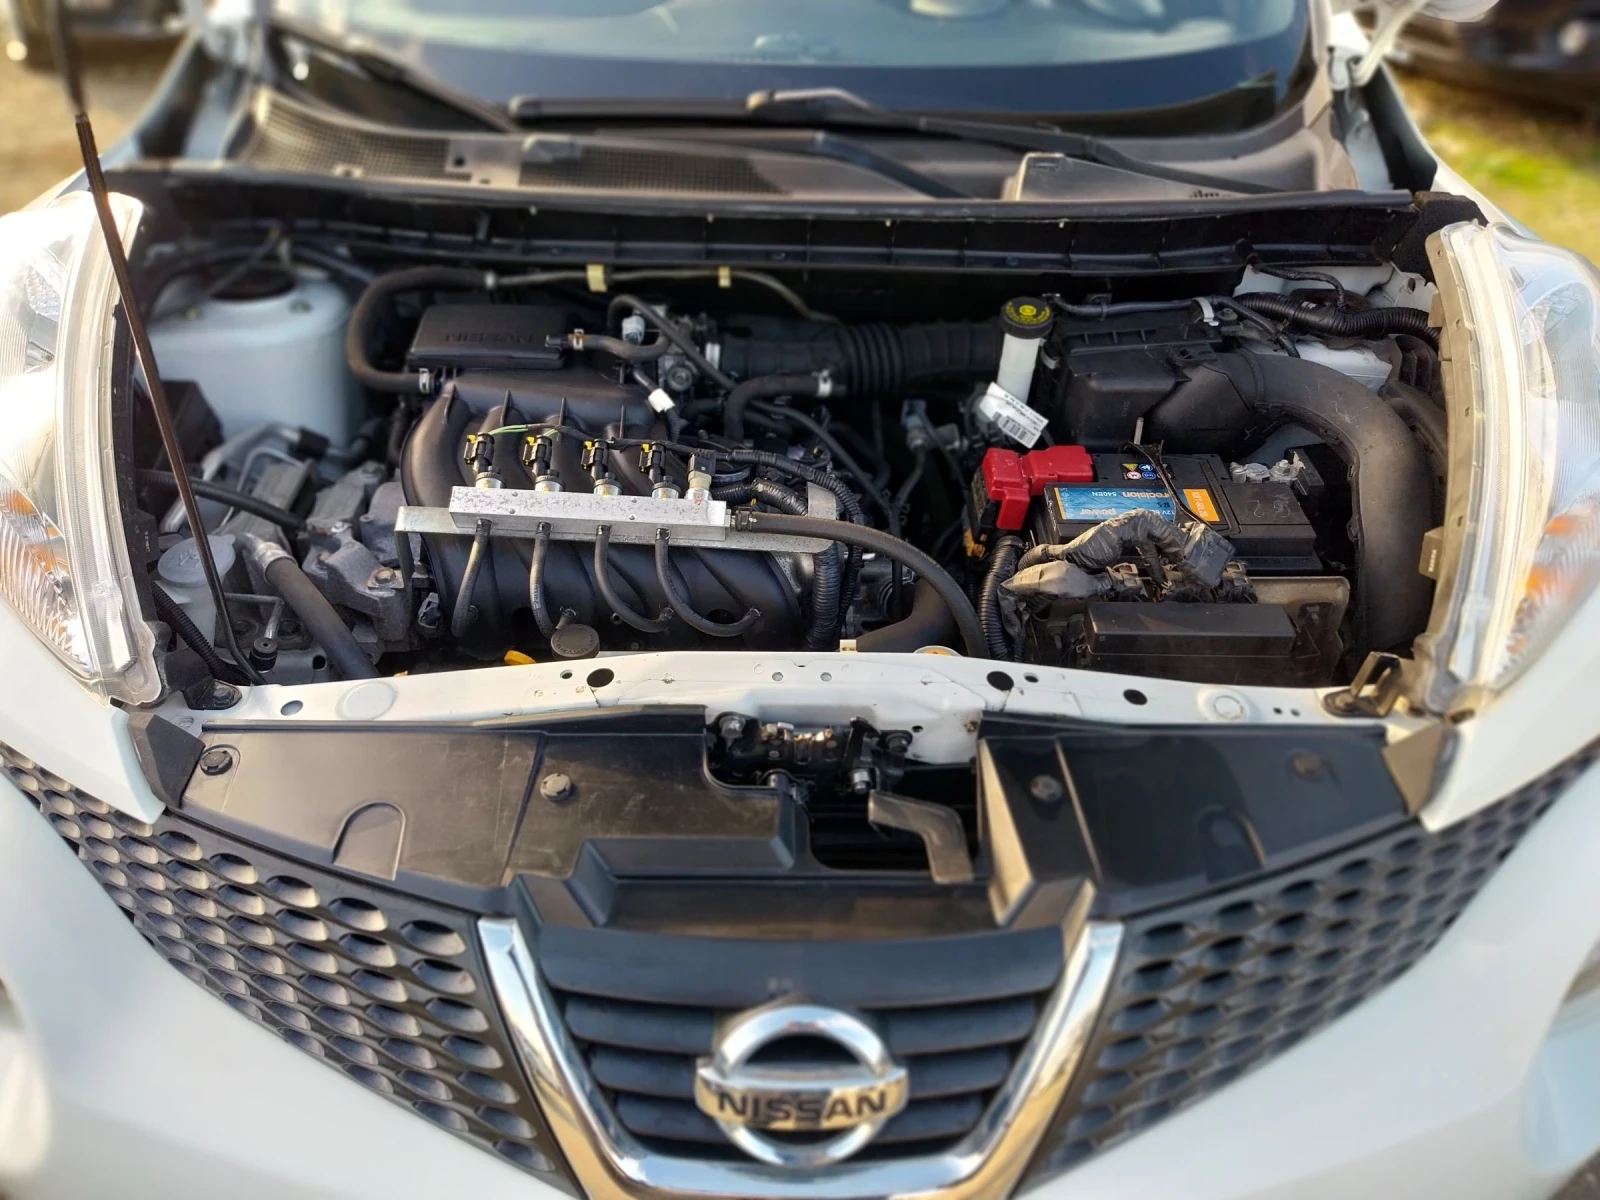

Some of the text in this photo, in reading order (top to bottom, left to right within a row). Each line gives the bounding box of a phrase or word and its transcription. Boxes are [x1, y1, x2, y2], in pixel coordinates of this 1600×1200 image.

[445, 332, 534, 344] NISSAN
[1079, 507, 1117, 516] power
[718, 1089, 887, 1121] NISSAN
